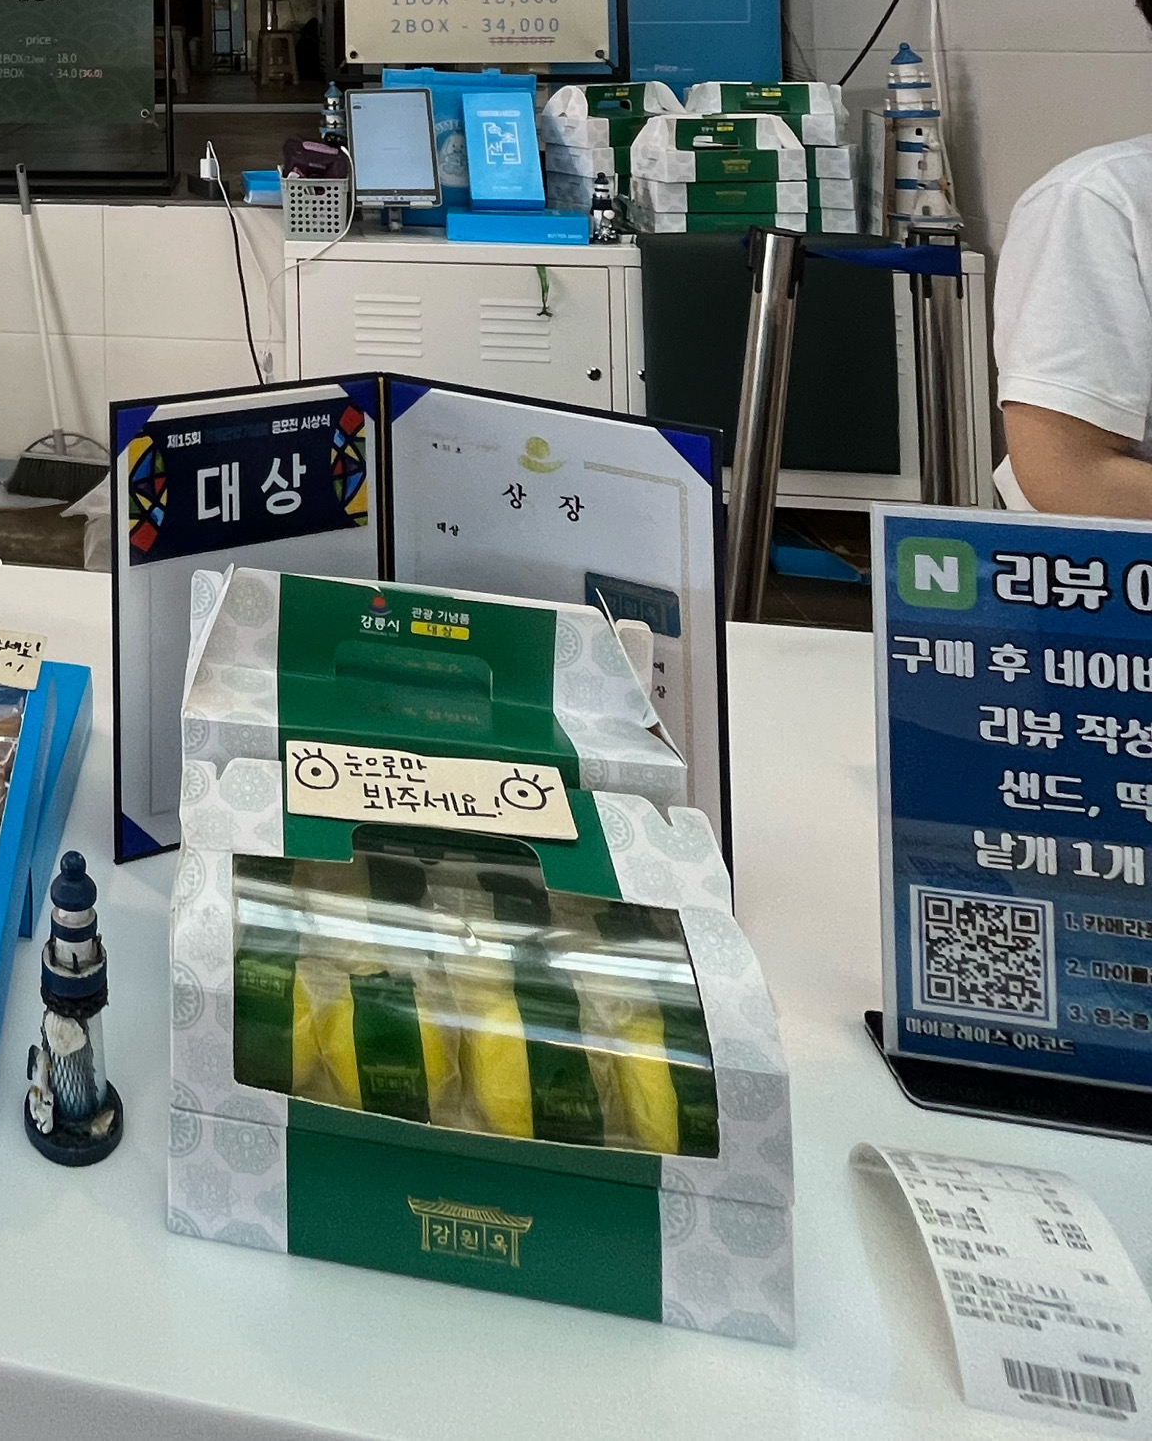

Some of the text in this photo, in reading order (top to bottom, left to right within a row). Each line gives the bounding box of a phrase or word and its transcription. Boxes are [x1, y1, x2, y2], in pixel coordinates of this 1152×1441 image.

[391, 17, 560, 35] 2BOX 34,000
[167, 431, 201, 448] 제15회
[301, 414, 331, 430] 시상식
[914, 554, 960, 592] N
[996, 554, 1108, 609] 리뷰
[360, 615, 400, 633] 강릉시
[411, 607, 470, 625] 관광 기념품
[892, 636, 974, 678] 구매
[988, 643, 1031, 683] 후
[979, 705, 1064, 749] 리뷰
[344, 752, 427, 783] 눈으로만
[363, 782, 503, 818] 봐주세요!
[998, 770, 1101, 819] 샌드,
[973, 830, 1145, 885] 낱개 1개
[1064, 912, 1152, 940] 1. 카메라
[1068, 1003, 1088, 1023] 3.
[1012, 1032, 1076, 1055] QR코드
[432, 1225, 508, 1256] 강원옥
